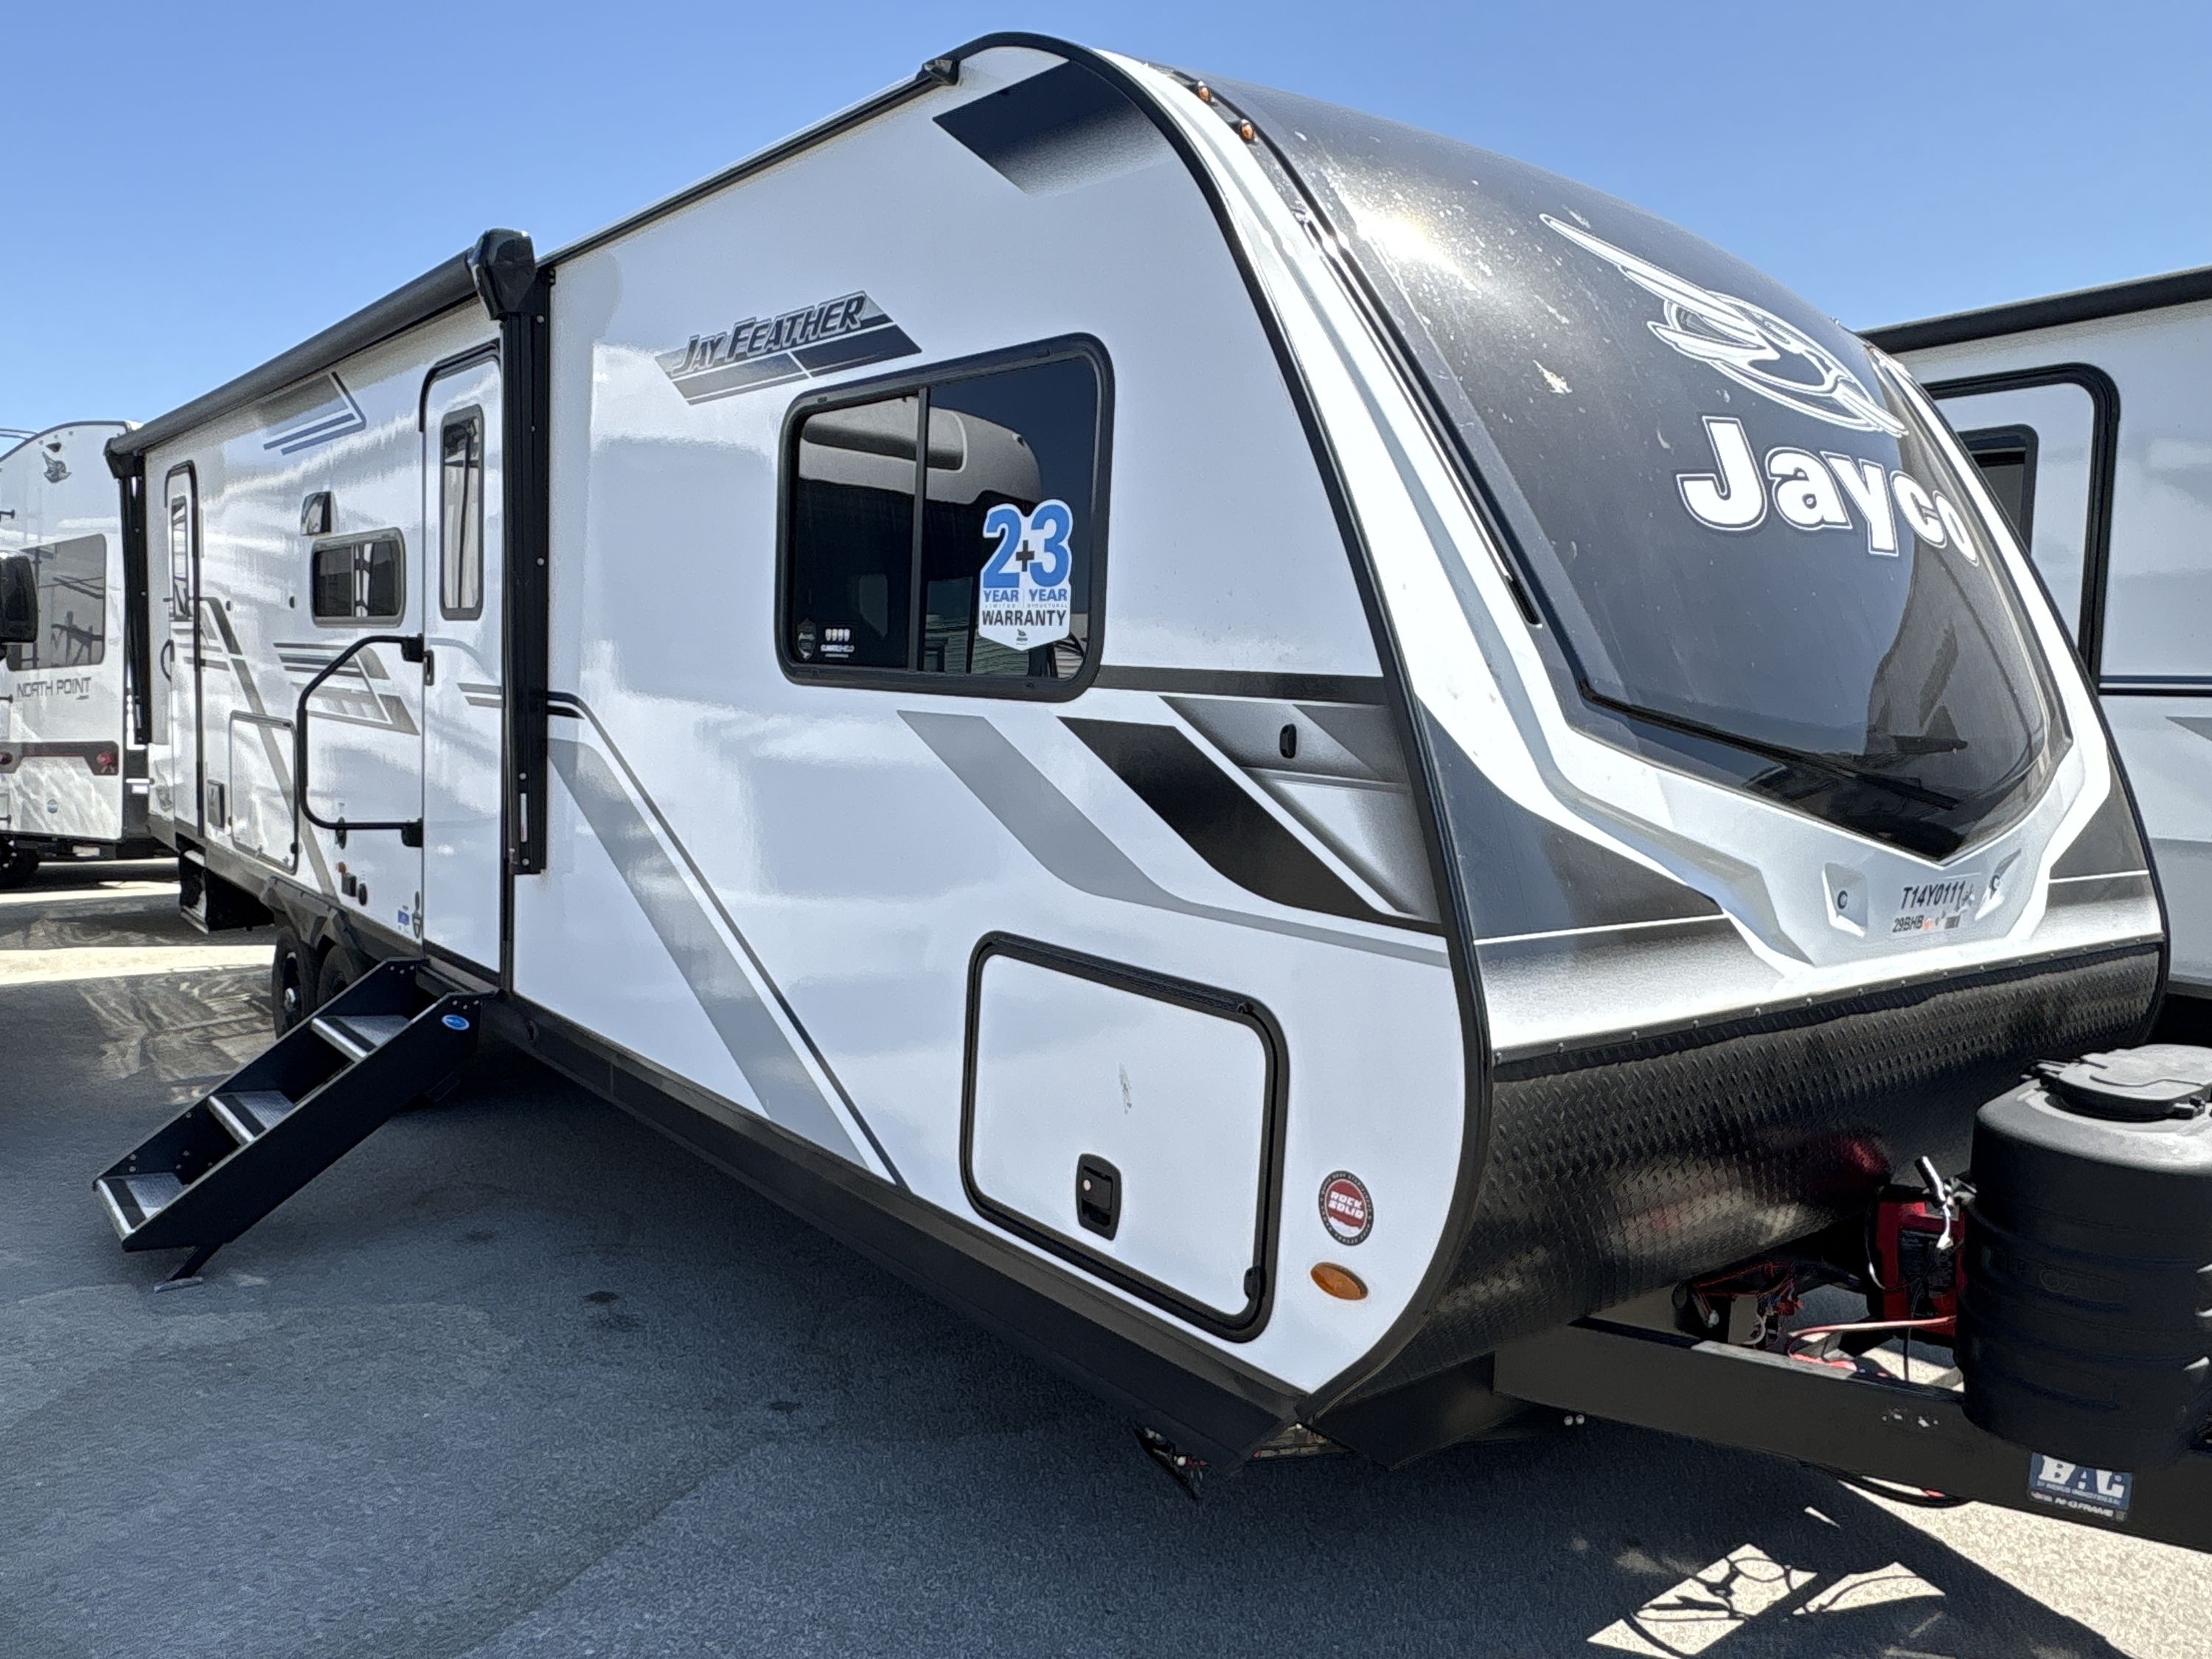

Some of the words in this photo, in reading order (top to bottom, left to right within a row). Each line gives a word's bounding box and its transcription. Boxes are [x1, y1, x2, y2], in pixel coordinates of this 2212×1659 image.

[672, 335, 726, 375] JAY
[726, 293, 867, 361] FEATHER
[1675, 414, 1979, 566] Jayco
[984, 589, 1020, 602] YEAR
[1029, 588, 1068, 602] YEAR
[982, 610, 1067, 626] WARRANTY
[17, 680, 53, 698] NORTH
[57, 677, 91, 695] POINT
[1328, 1199, 1365, 1219] SOLID
[1330, 1191, 1363, 1209] ROCK
